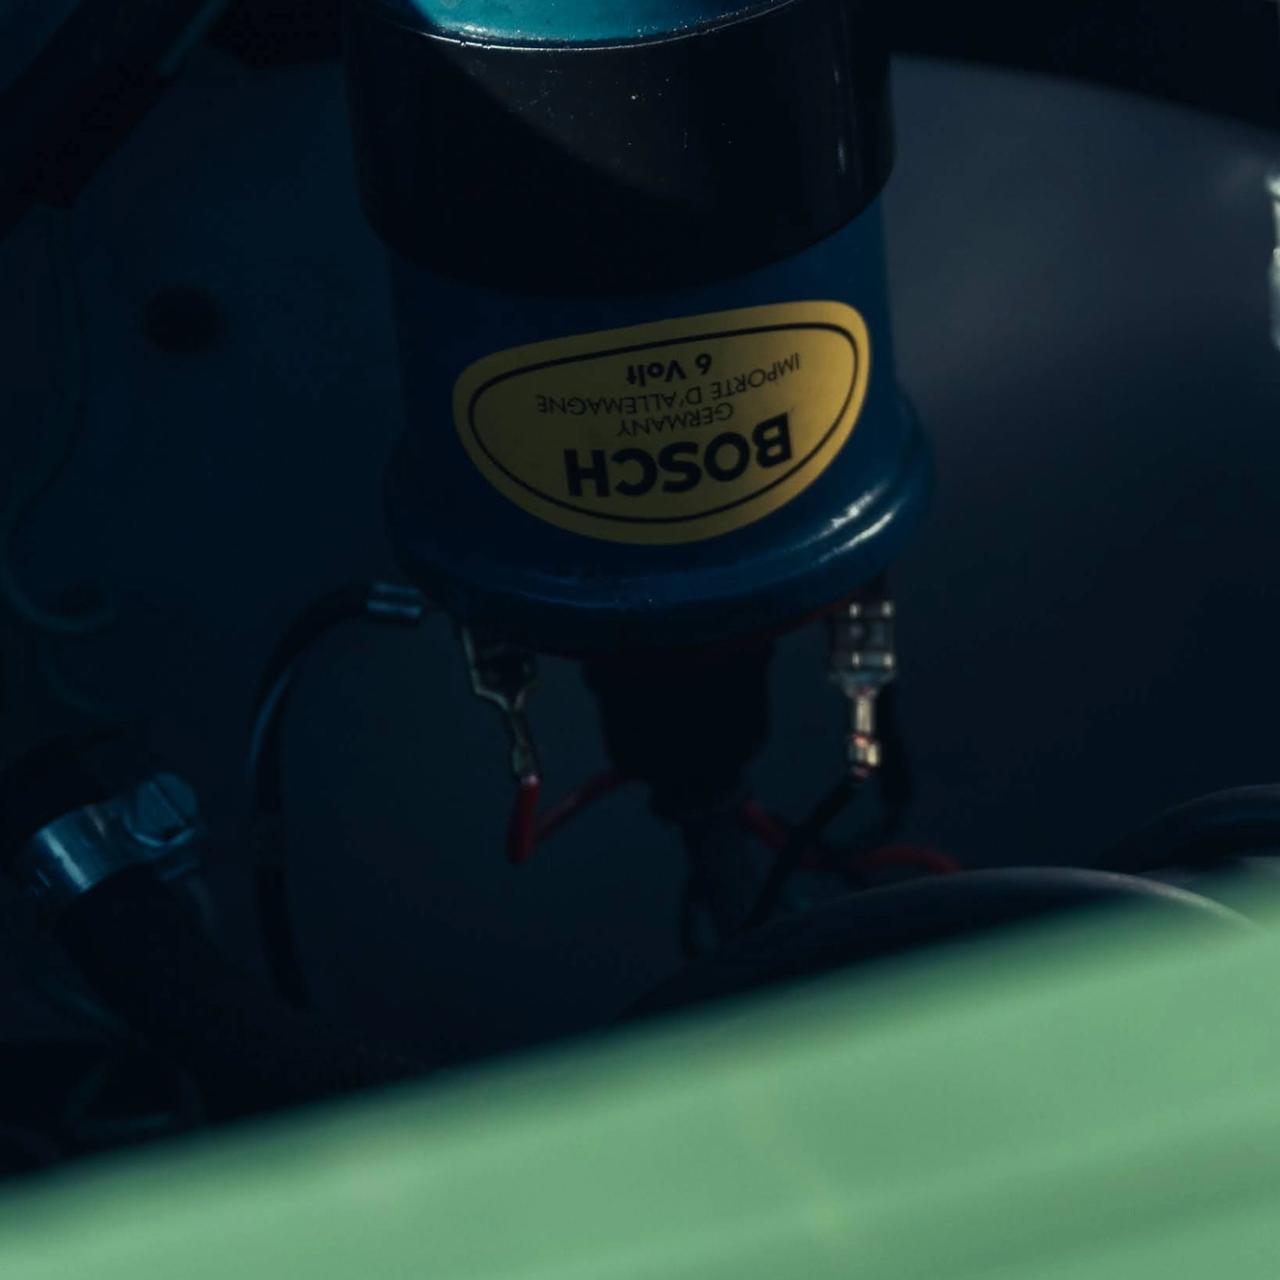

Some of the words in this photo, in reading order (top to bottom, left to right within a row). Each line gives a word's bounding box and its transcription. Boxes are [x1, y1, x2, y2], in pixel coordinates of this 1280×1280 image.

[626, 359, 687, 387] Volt
[694, 353, 713, 375] 6
[712, 352, 800, 401] IMPORTE
[537, 387, 702, 416] D'ALLEMAGNE
[617, 402, 734, 438] GERMANY
[564, 413, 793, 498] BOSCH
